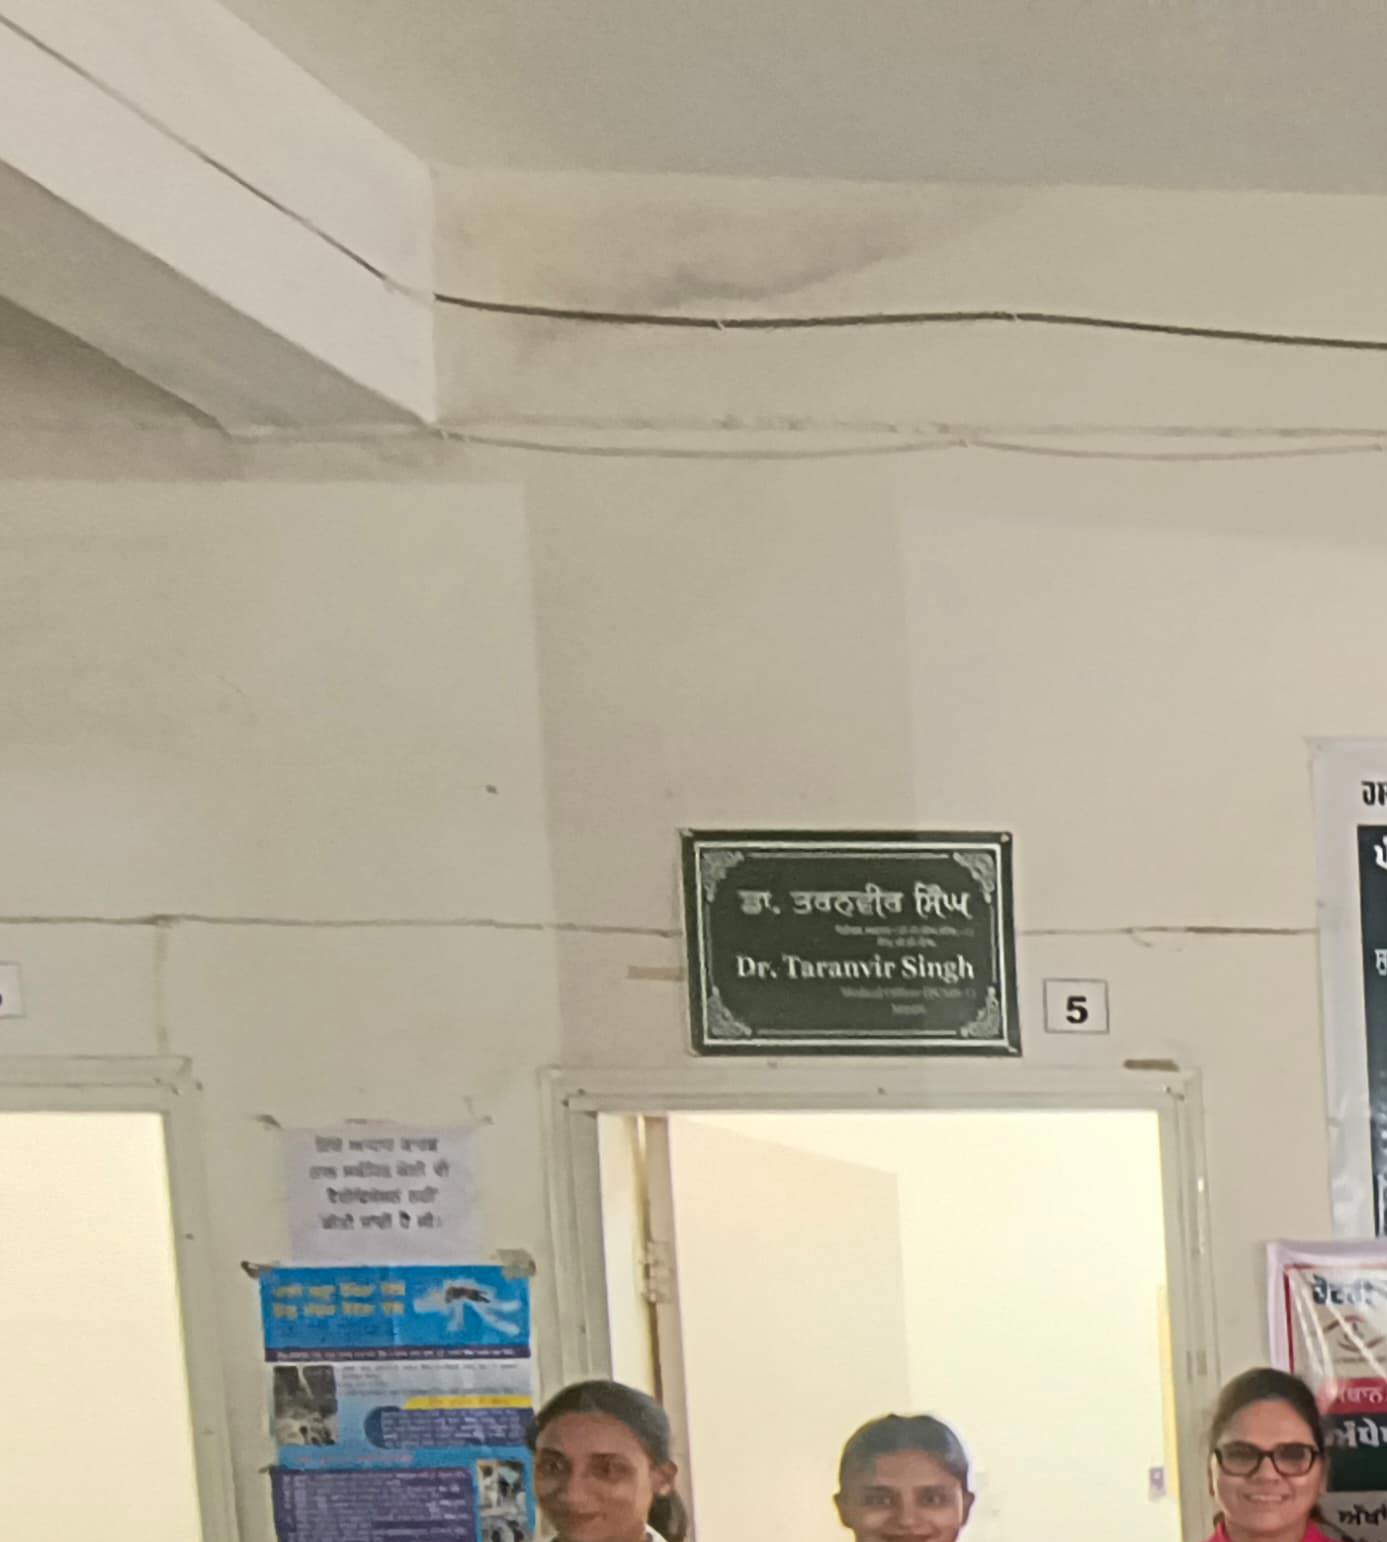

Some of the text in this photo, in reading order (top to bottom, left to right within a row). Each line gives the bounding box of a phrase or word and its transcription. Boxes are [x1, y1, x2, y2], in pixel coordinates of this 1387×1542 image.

[789, 882, 904, 918] ਤਰਨਵੀਰ
[736, 953, 975, 984] Dr. Taranvir Singh
[1066, 995, 1089, 1024] 5
